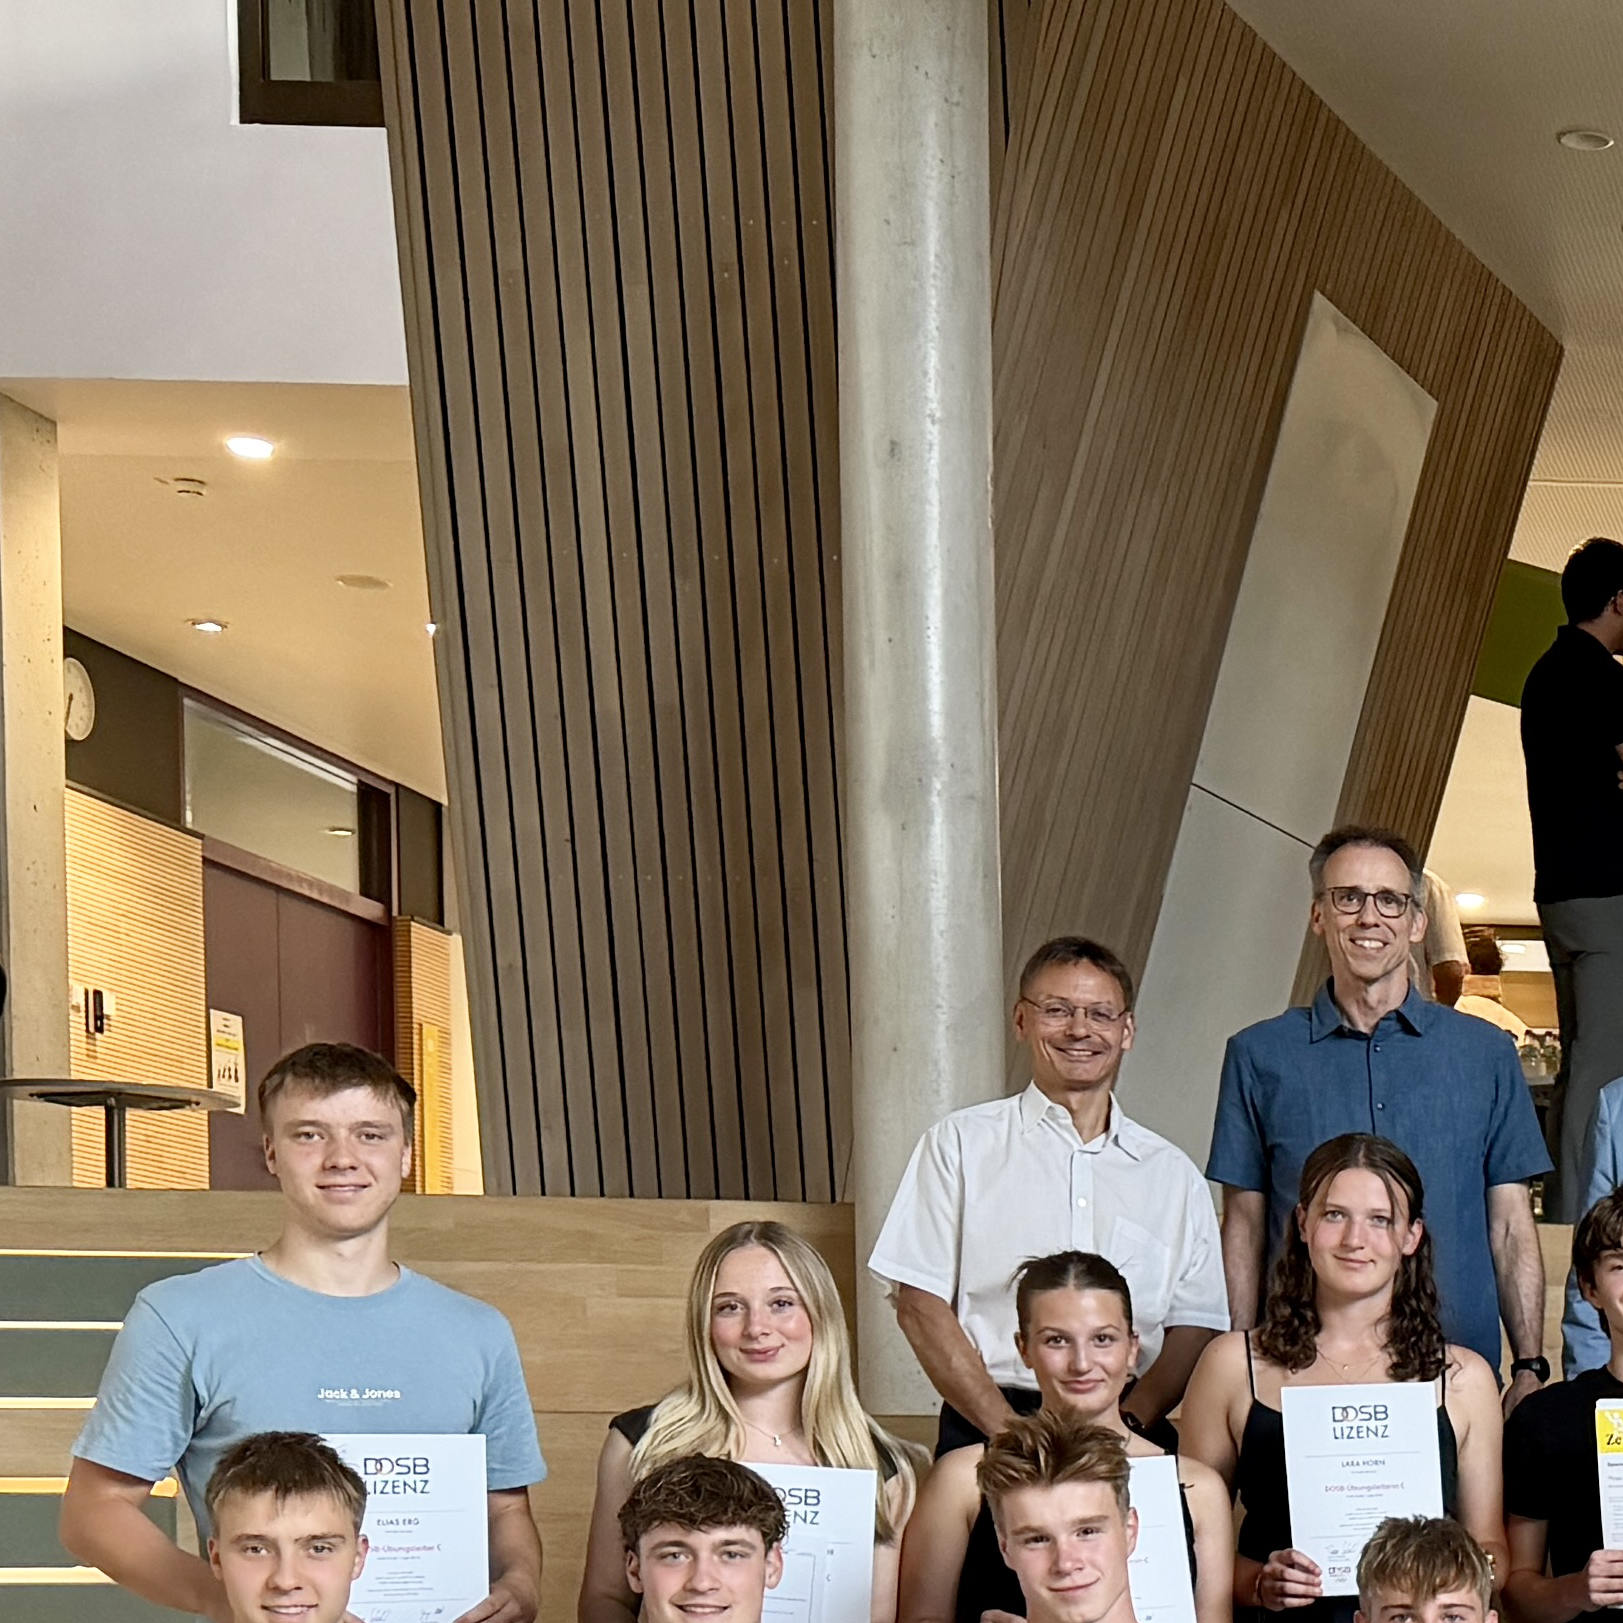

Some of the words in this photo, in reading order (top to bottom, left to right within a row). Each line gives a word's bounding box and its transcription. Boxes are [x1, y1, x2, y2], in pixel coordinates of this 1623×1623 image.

[317, 1388, 348, 1400] Jack
[349, 1388, 360, 1400] &
[362, 1388, 401, 1400] Jones
[1331, 1404, 1389, 1423] DOSB
[1333, 1424, 1389, 1440] LIZENZ
[363, 1457, 430, 1476] DOSB
